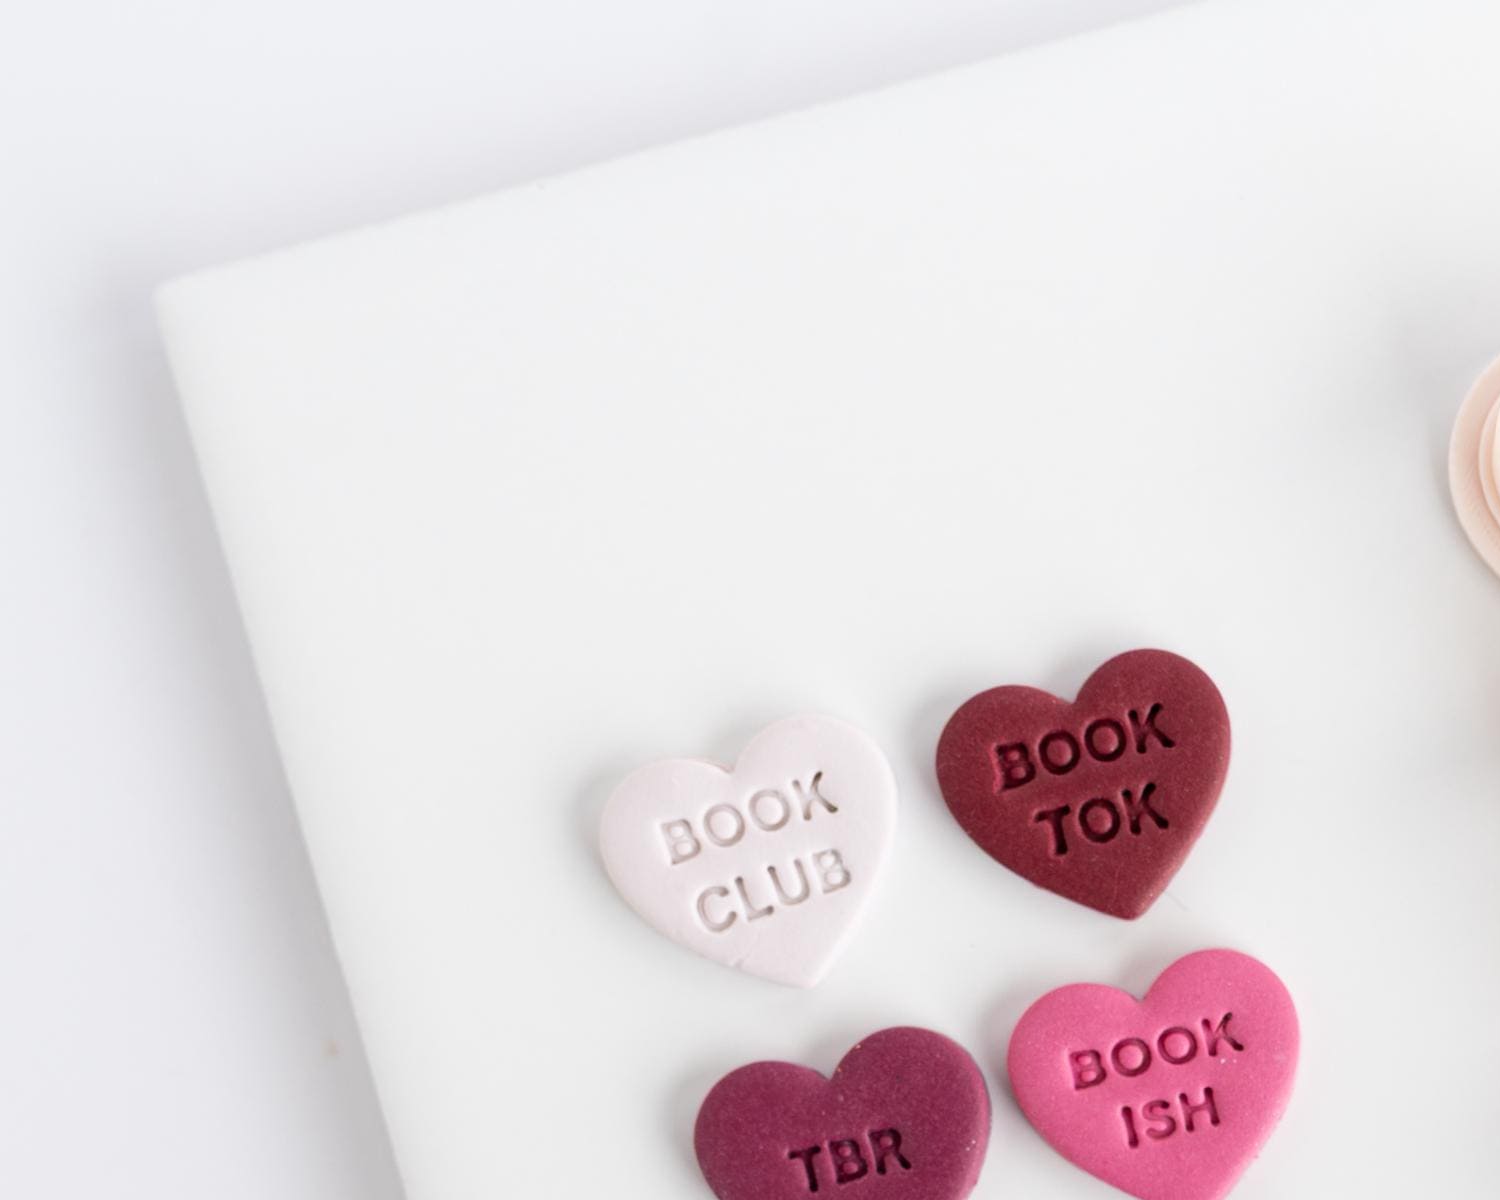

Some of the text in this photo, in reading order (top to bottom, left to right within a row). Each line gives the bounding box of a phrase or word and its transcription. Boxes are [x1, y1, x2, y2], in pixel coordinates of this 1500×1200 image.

[991, 702, 1175, 792] BOOK
[660, 770, 839, 866] BOOK
[1034, 781, 1170, 857] TOK
[696, 848, 852, 933] CLUB
[1069, 1011, 1245, 1092] BOOK
[1120, 1086, 1222, 1148] ISH
[788, 1126, 913, 1193] TBR
